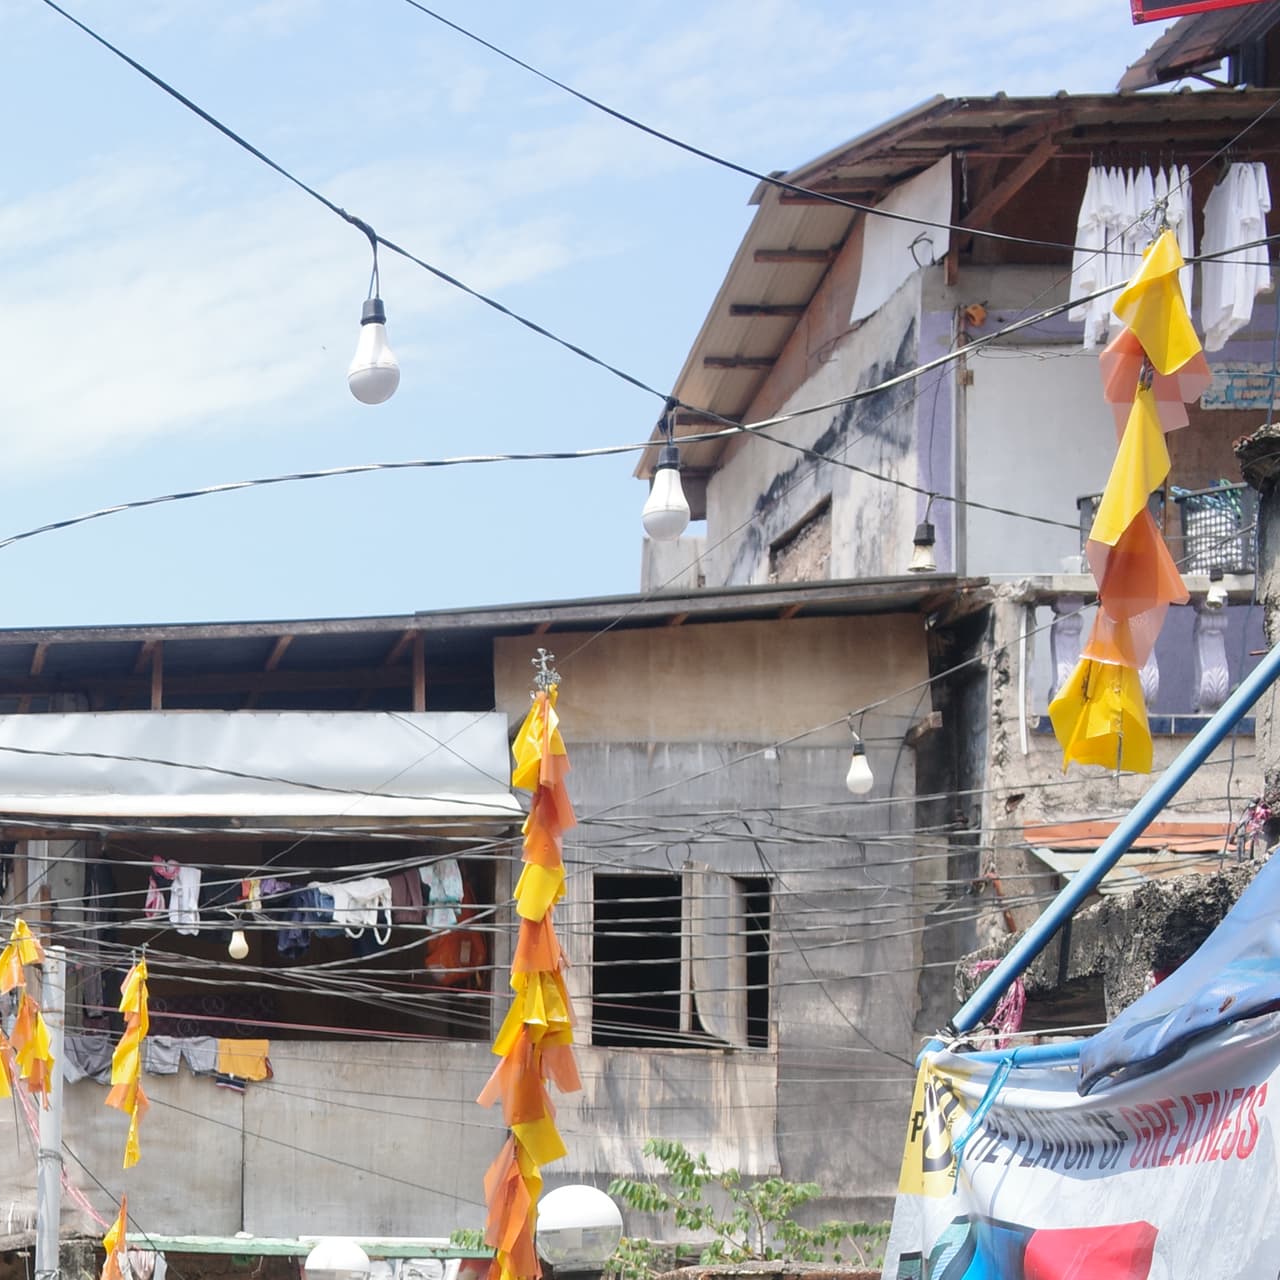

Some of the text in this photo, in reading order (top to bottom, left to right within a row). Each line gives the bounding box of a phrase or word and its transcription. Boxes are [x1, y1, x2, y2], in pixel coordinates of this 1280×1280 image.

[1002, 1108, 1094, 1171] FLAVOR
[1093, 1108, 1128, 1171] OF
[1123, 1083, 1269, 1168] GREATNESS
